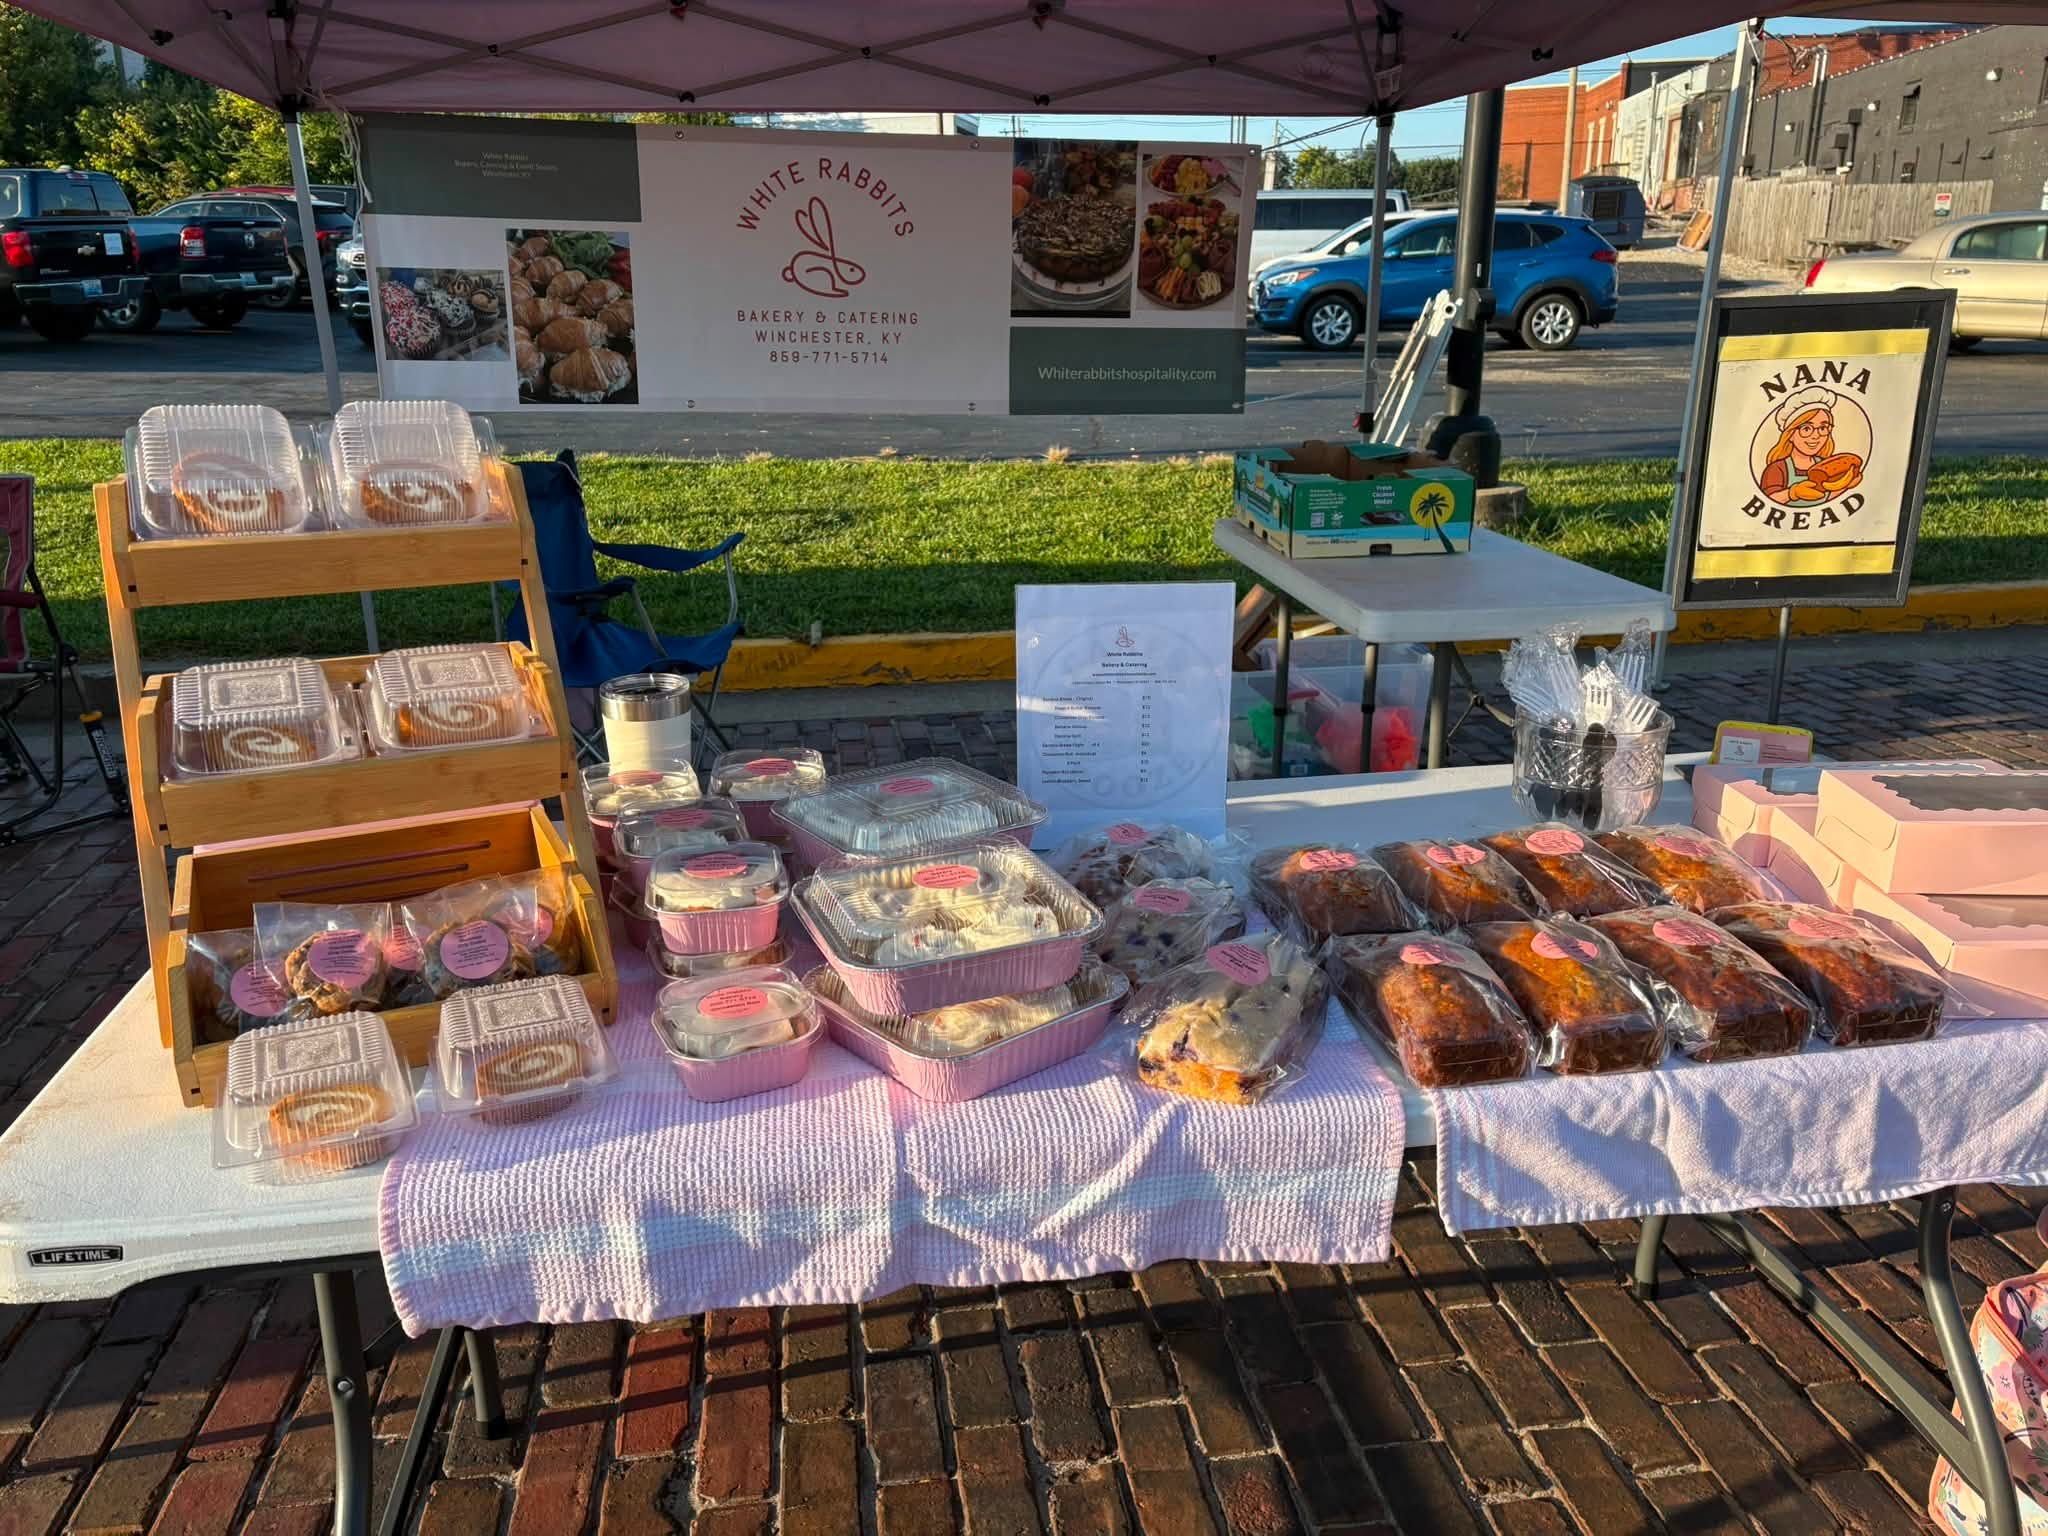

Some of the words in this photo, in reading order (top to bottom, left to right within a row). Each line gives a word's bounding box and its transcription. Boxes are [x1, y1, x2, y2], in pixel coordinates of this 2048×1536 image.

[736, 162, 804, 230] WHITE
[818, 158, 914, 237] RABBITS
[737, 310, 804, 322] BAKERY
[815, 311, 826, 323] &
[837, 312, 918, 325] CATERING
[882, 332, 902, 344] KY
[1038, 366, 1217, 382] Whiterabbitshospitality.com
[1760, 361, 1871, 402] NANA
[1741, 493, 1865, 530] BREAD
[41, 1250, 111, 1262] LIFETIME
